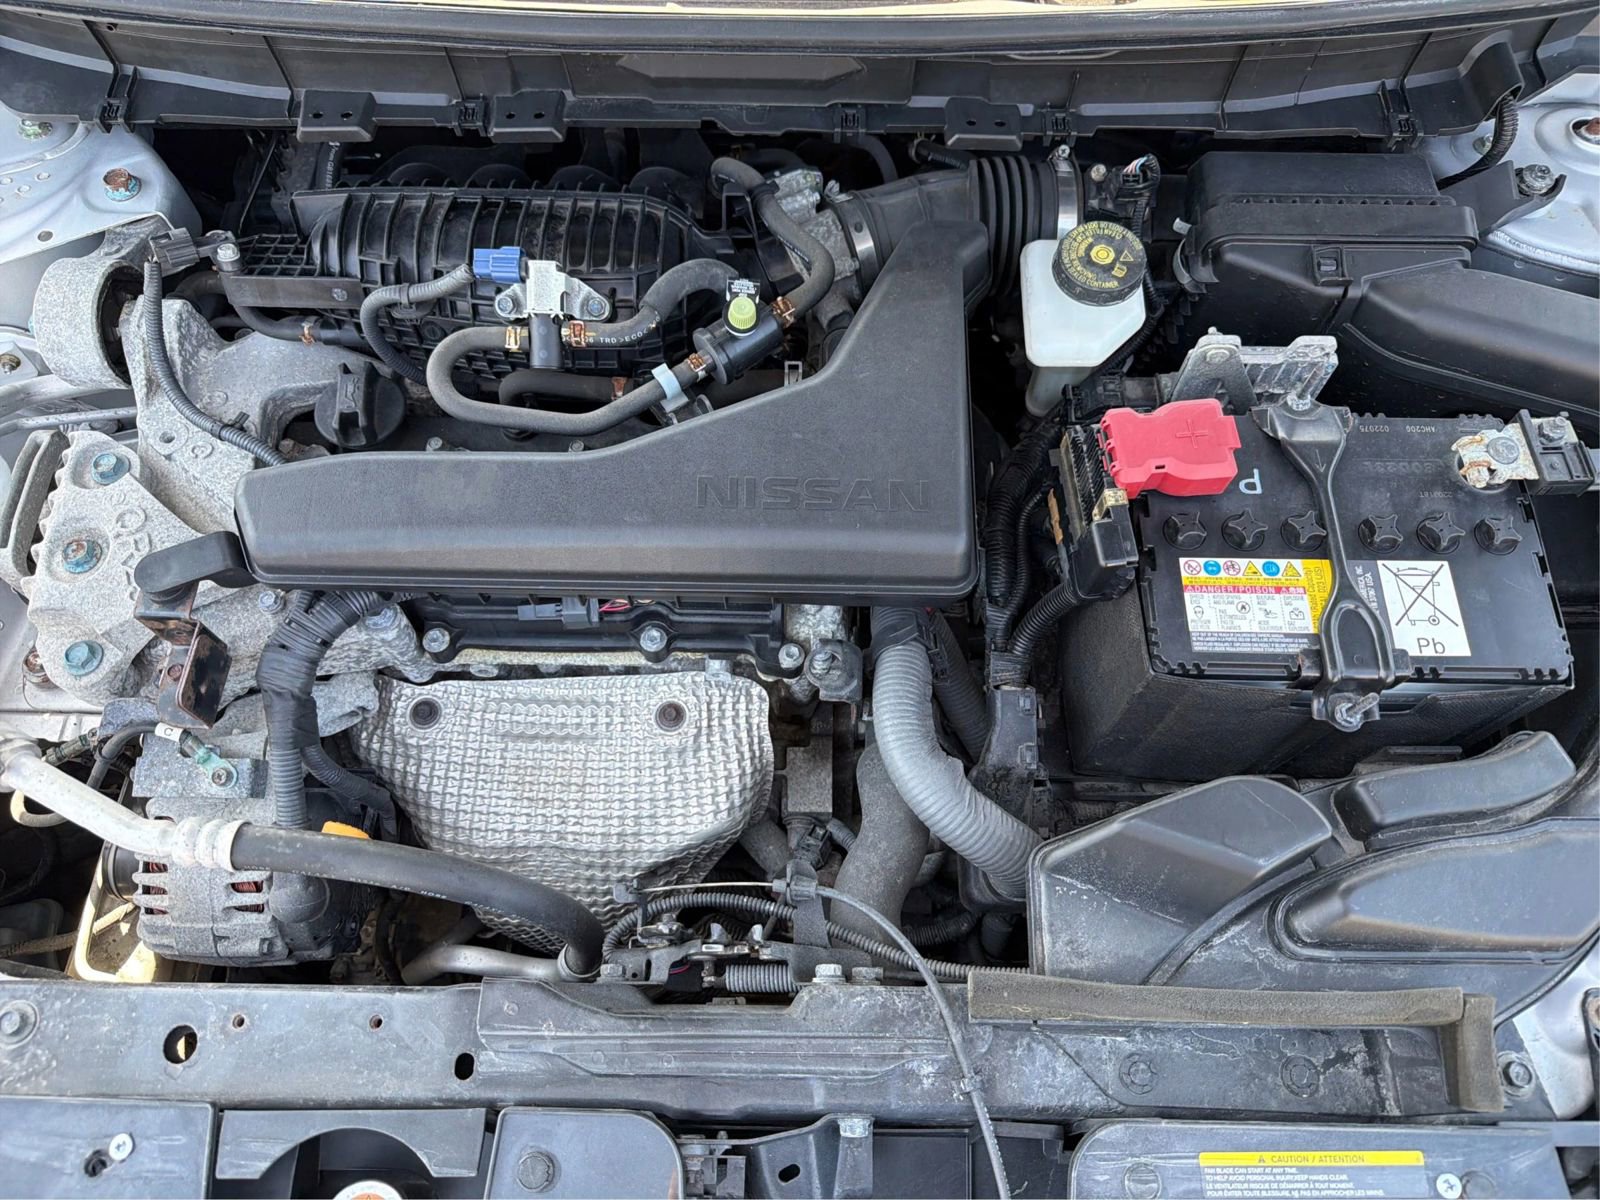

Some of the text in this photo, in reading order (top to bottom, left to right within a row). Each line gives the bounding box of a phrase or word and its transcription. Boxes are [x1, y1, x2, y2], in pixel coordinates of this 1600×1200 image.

[1103, 228, 1124, 240] CLEAN
[1085, 279, 1118, 289] CONTAINER
[696, 475, 929, 512] NISSAN
[1416, 637, 1446, 654] Pb
[1271, 1155, 1309, 1164] CAUTION
[1319, 1154, 1365, 1163] ATTENTION
